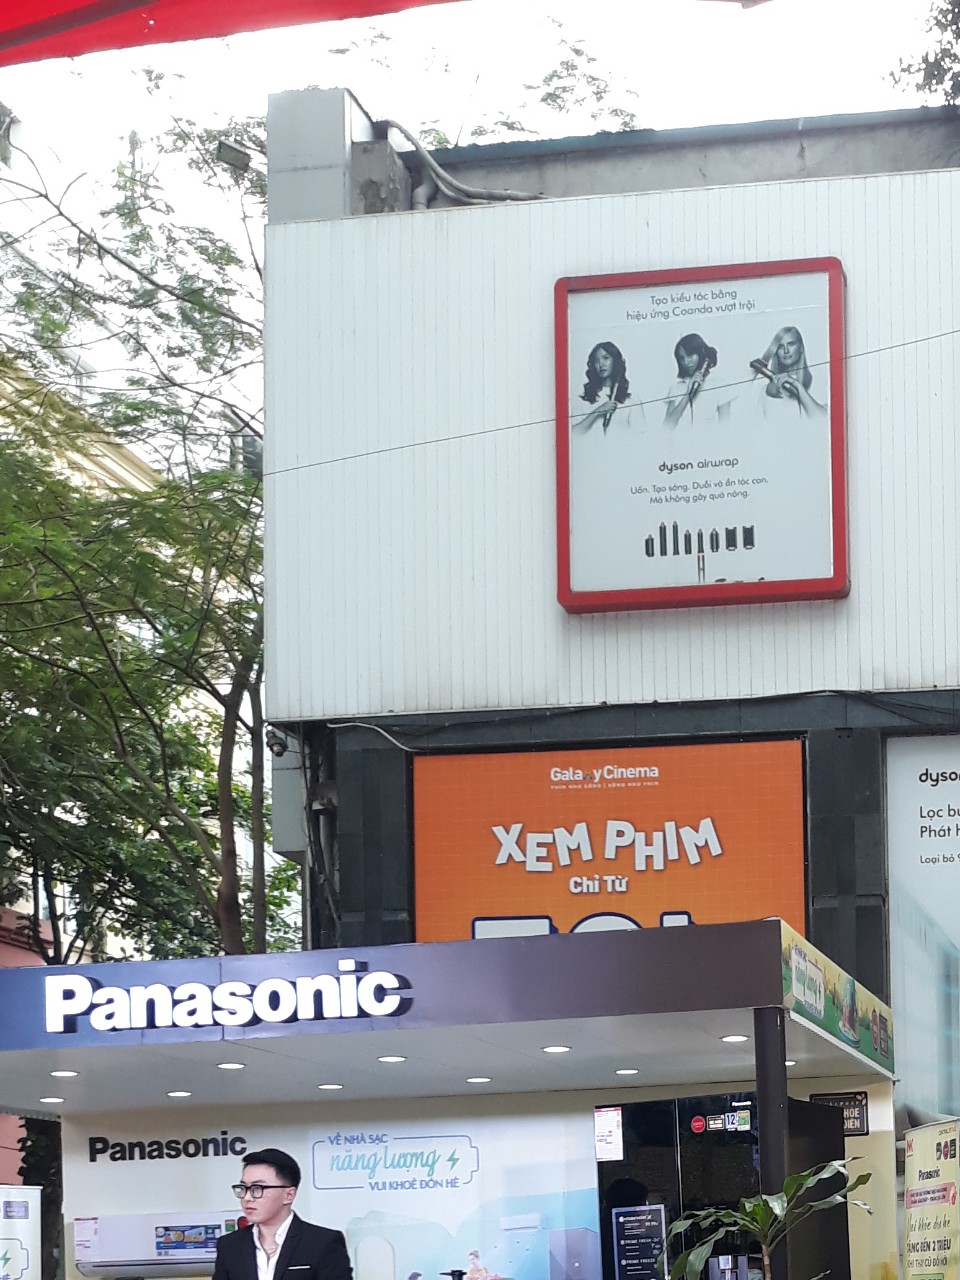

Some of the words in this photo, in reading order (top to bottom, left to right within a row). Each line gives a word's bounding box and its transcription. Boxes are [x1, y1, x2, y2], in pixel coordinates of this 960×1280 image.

[650, 294, 668, 307] Tạo
[693, 291, 709, 302] tóc
[626, 309, 648, 321] hiệu
[672, 304, 713, 318] Coanda
[738, 300, 756, 312] trội
[659, 460, 694, 474] dyson
[697, 456, 740, 471] airwrap
[603, 764, 659, 779] Cinema
[919, 804, 944, 821] Lọc
[919, 822, 952, 838] Phát
[491, 821, 593, 873] XEM
[604, 816, 724, 872] PHIM
[919, 853, 940, 866] Loại
[942, 851, 955, 864] bỏ
[568, 873, 600, 895] Chỉ
[603, 874, 629, 893] Từ
[45, 958, 412, 1033] Panasonic
[726, 1114, 736, 1125] 12
[88, 1130, 248, 1163] Panasonic
[343, 1133, 367, 1145] NHÀ
[369, 1133, 388, 1146] SẠC
[368, 1180, 387, 1191] VUI
